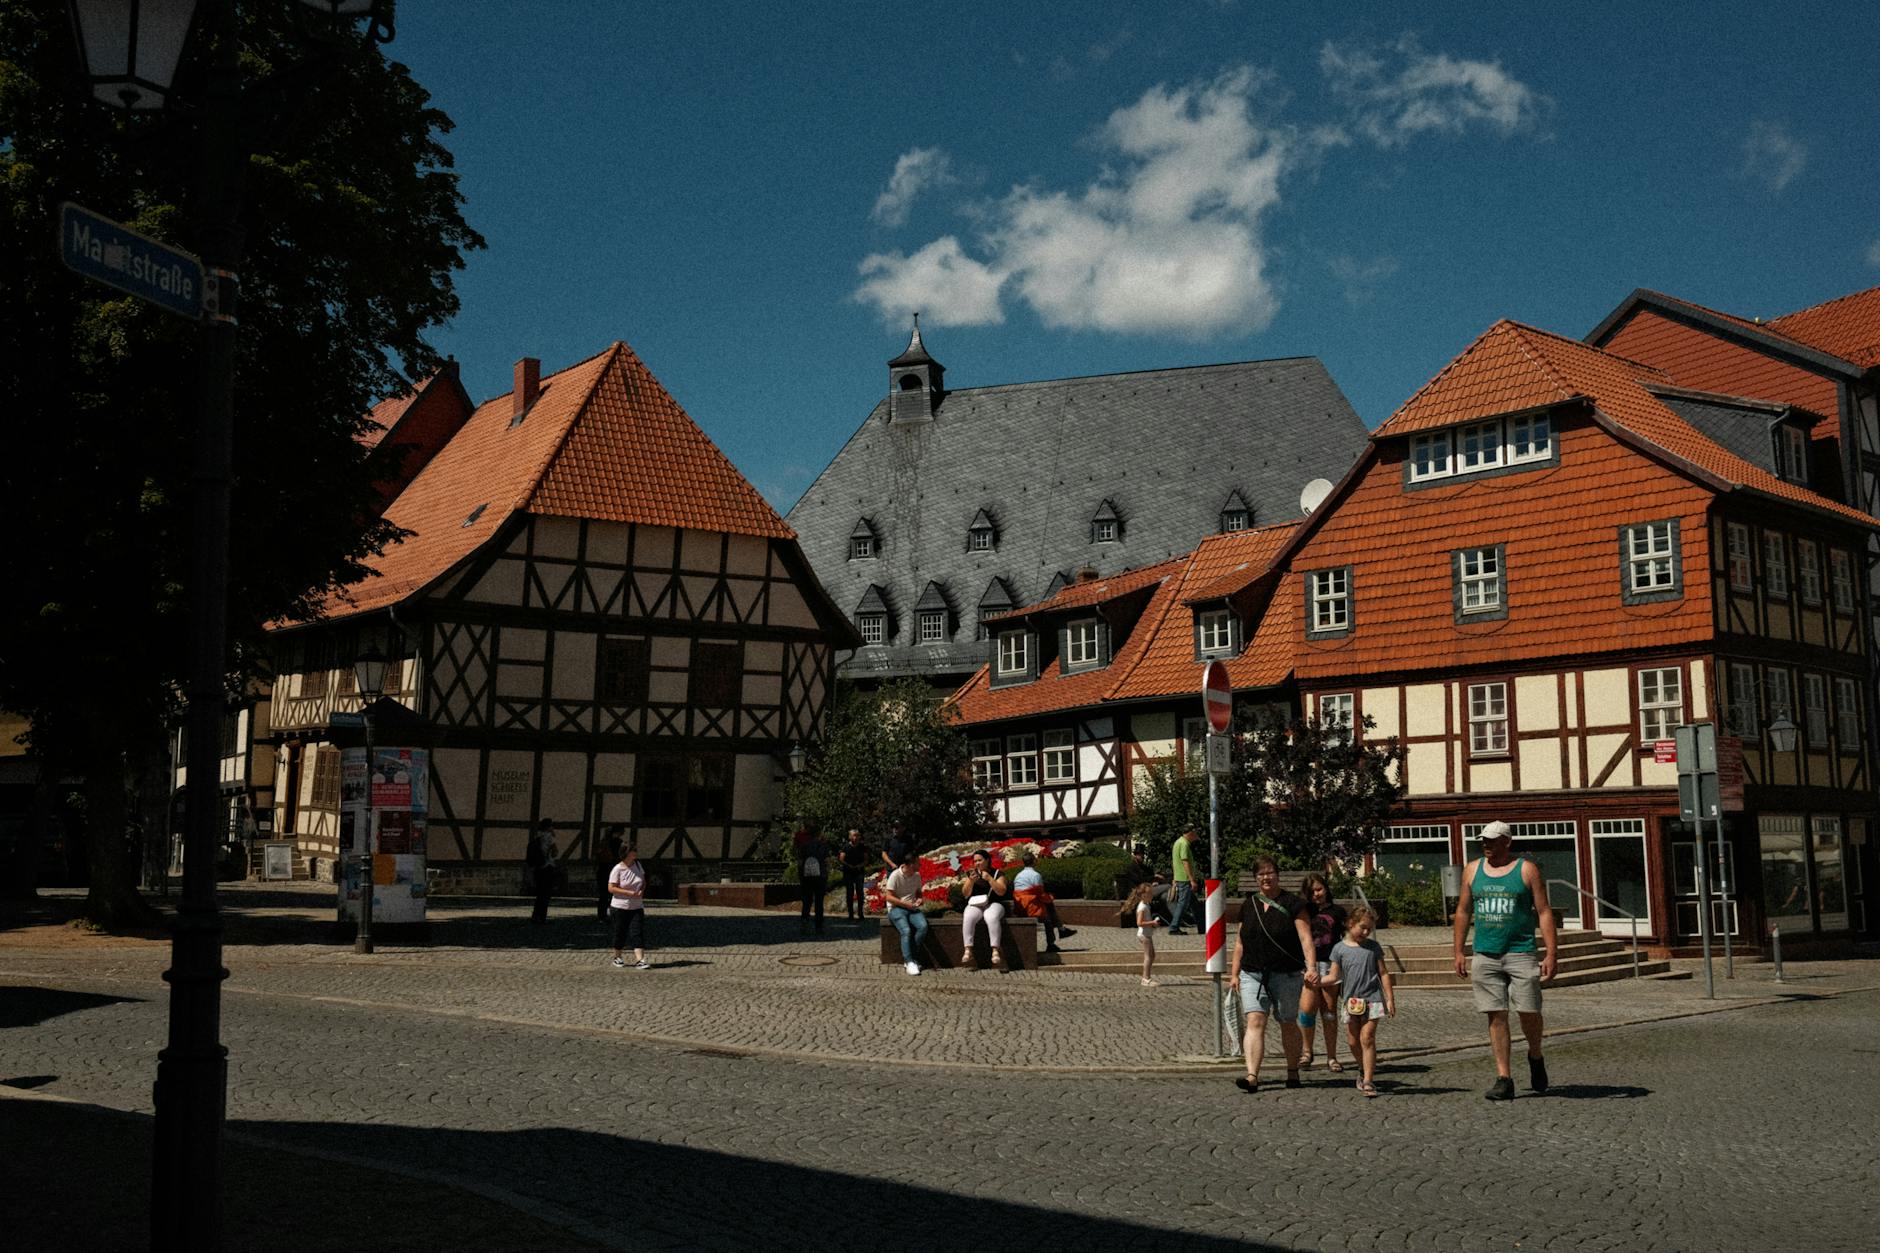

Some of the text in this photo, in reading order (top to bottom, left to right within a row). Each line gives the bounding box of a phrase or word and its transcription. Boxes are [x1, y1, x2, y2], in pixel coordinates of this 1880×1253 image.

[72, 220, 193, 300] Matstraße
[492, 769, 530, 781] MUSEUM
[490, 793, 514, 804] HAUS
[1477, 897, 1516, 914] SURF
